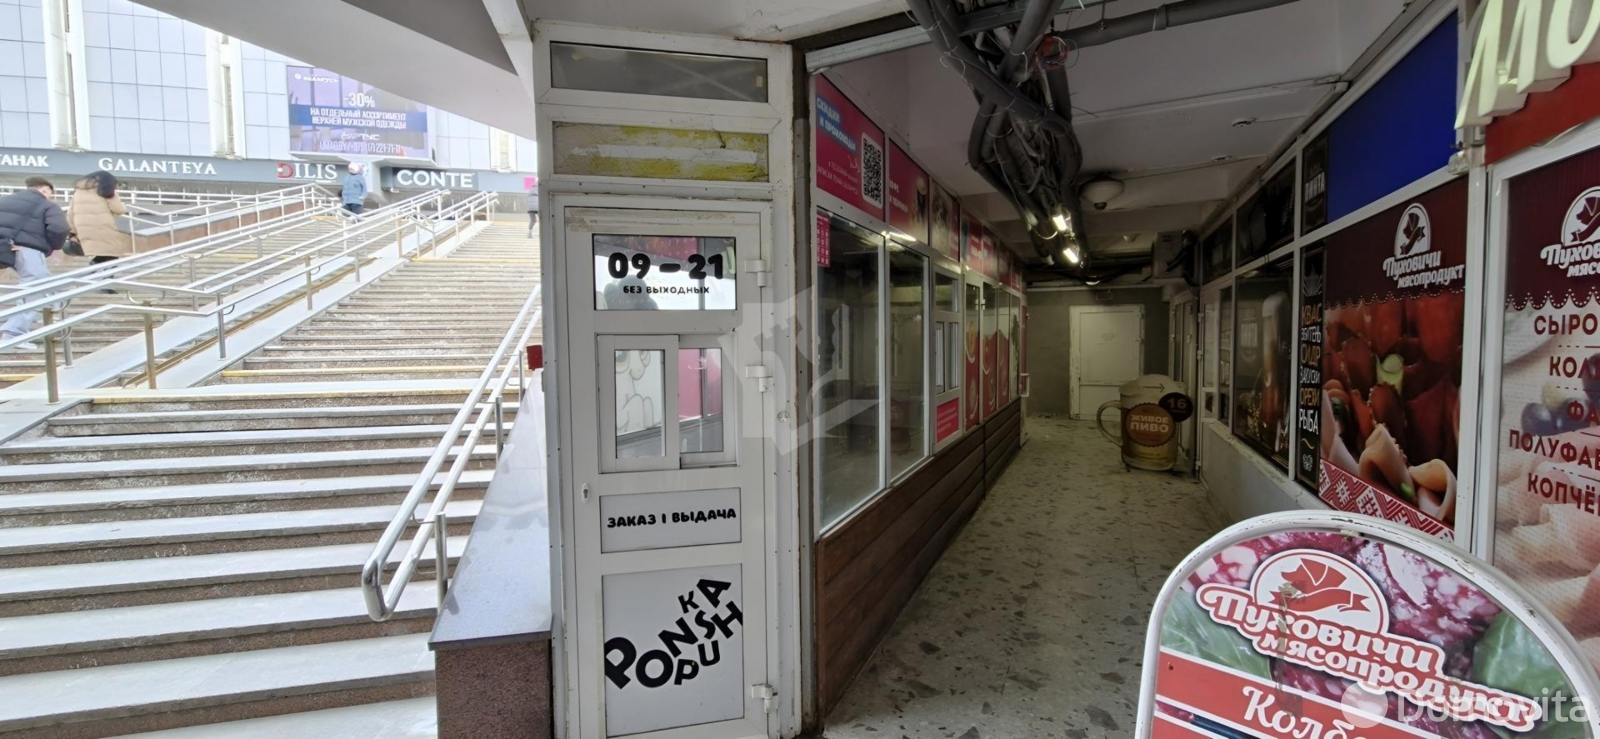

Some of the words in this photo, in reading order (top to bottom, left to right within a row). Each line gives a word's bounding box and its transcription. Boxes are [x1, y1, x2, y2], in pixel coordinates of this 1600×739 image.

[310, 107, 321, 116] НА
[321, 108, 361, 118] ОТДЕЛЬНЫЙ
[0, 153, 50, 168] АНАК
[98, 157, 217, 175] GALANTEYA
[276, 161, 338, 180] DILIS
[396, 169, 474, 188] CONTE
[608, 252, 651, 280] 09
[688, 253, 723, 280] 21
[1383, 250, 1442, 281] Пуховичи
[1397, 264, 1465, 289] мясопродукт
[623, 286, 642, 294] БЕЗ
[646, 286, 710, 295] ВЫХОДНЫХ
[1167, 397, 1188, 409] 16
[1130, 414, 1170, 424] ЖИВОЕ
[1130, 421, 1170, 433] ПИВО
[1299, 408, 1319, 435] РЫБА
[1528, 472, 1600, 517] КОПЧЁ
[607, 514, 657, 528] ЗАКАЗ
[671, 508, 737, 524] ВЫДАЧА
[1204, 590, 1432, 673] Пуховичи
